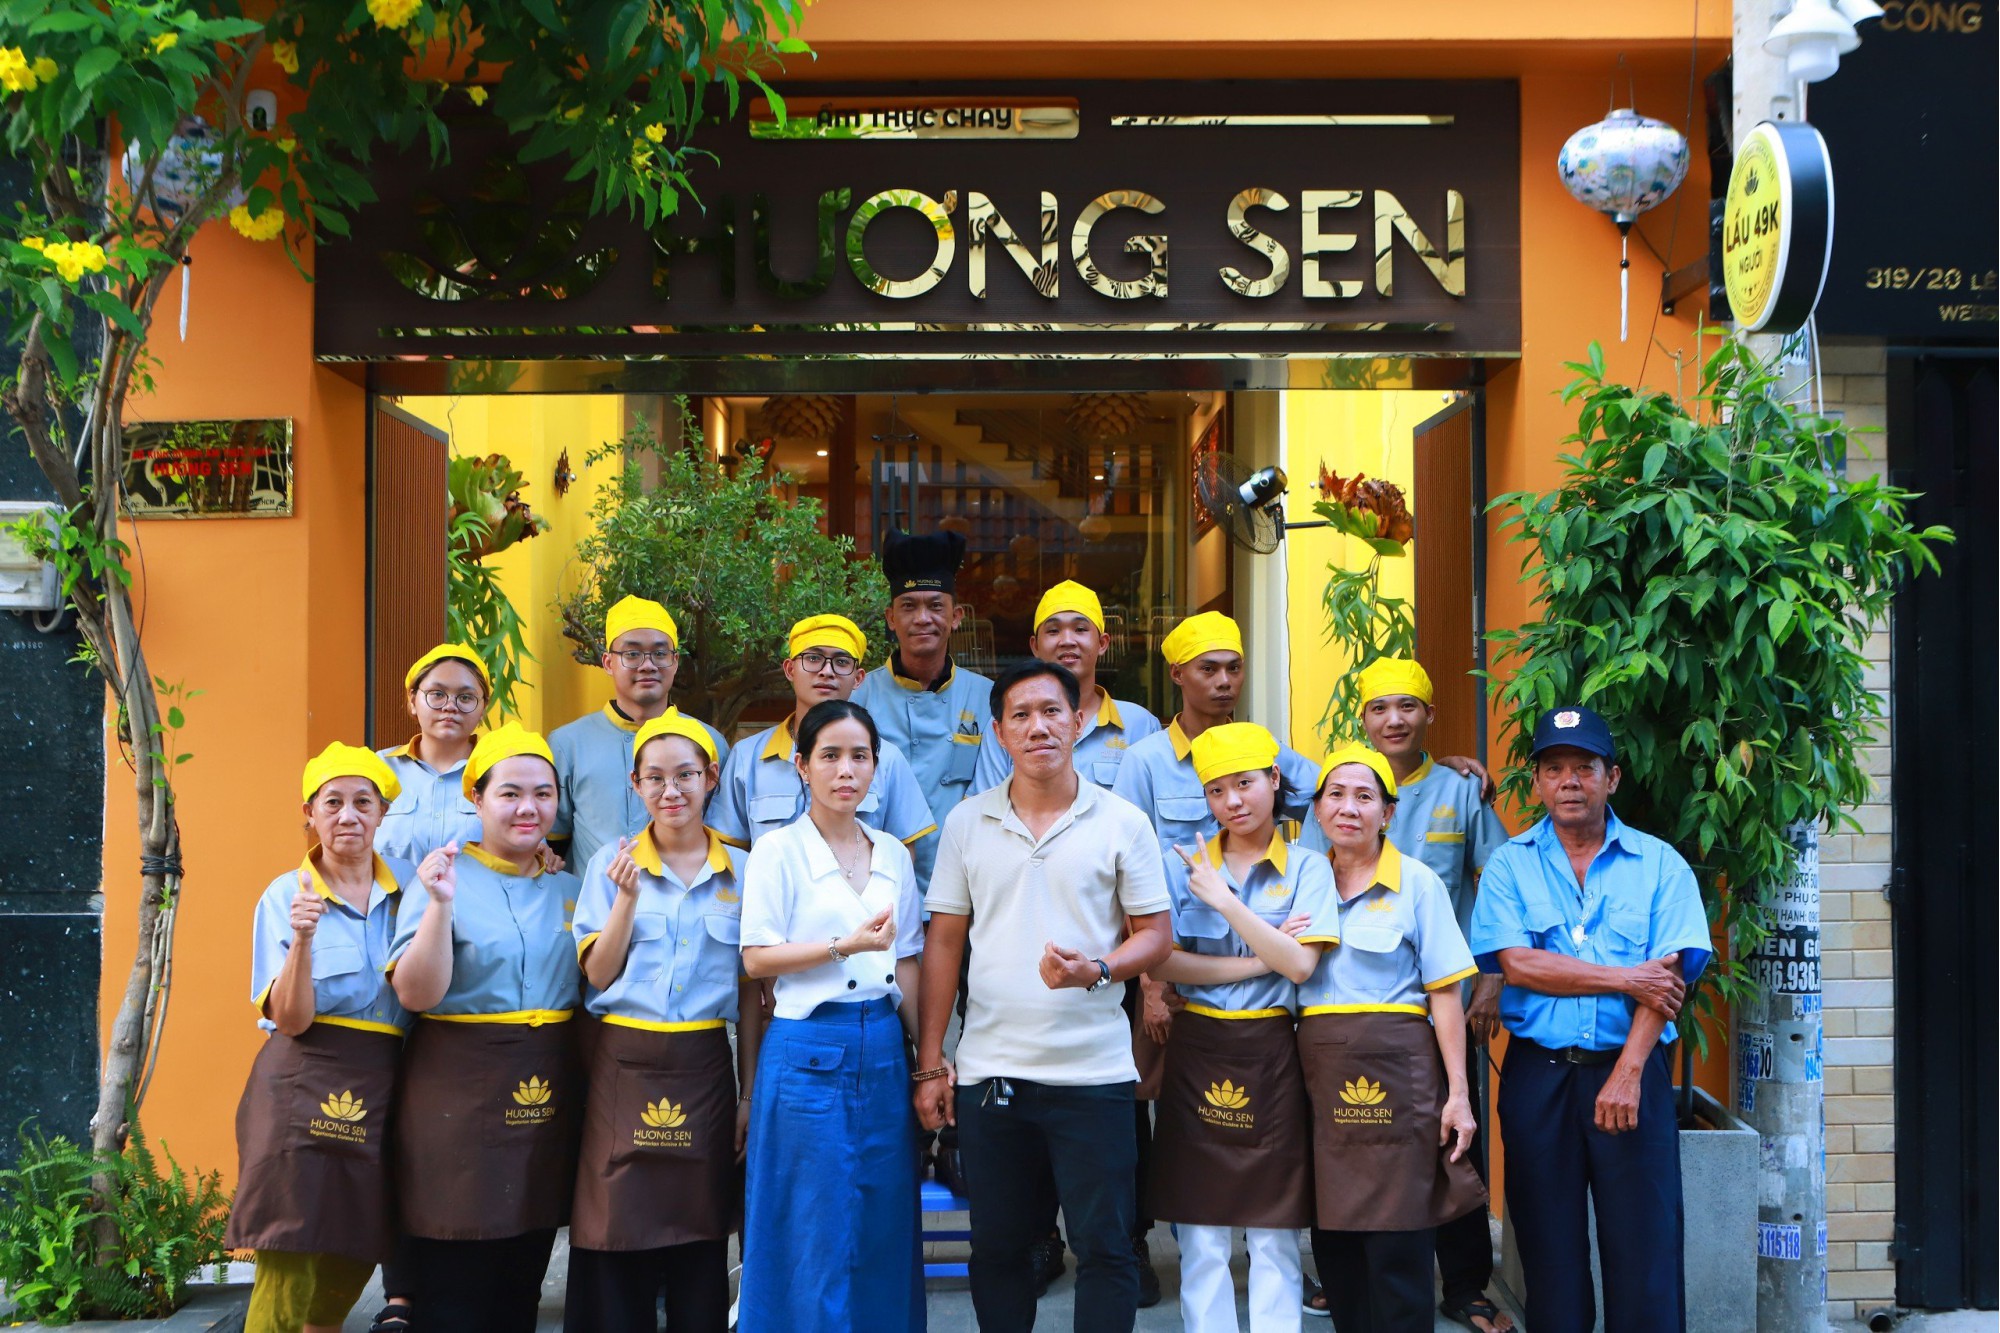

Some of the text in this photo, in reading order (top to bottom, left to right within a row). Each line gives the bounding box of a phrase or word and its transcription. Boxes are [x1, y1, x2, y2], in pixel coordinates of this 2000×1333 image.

[943, 107, 1012, 129] CHAY
[1754, 200, 1779, 239] 49K
[1219, 186, 1466, 298] SEN
[1865, 266, 1962, 290] 319/20
[1235, 1112, 1254, 1123] SEN
[1373, 1108, 1392, 1118] SEN
[351, 1125, 367, 1137] SEN
[674, 1130, 692, 1141] SEN
